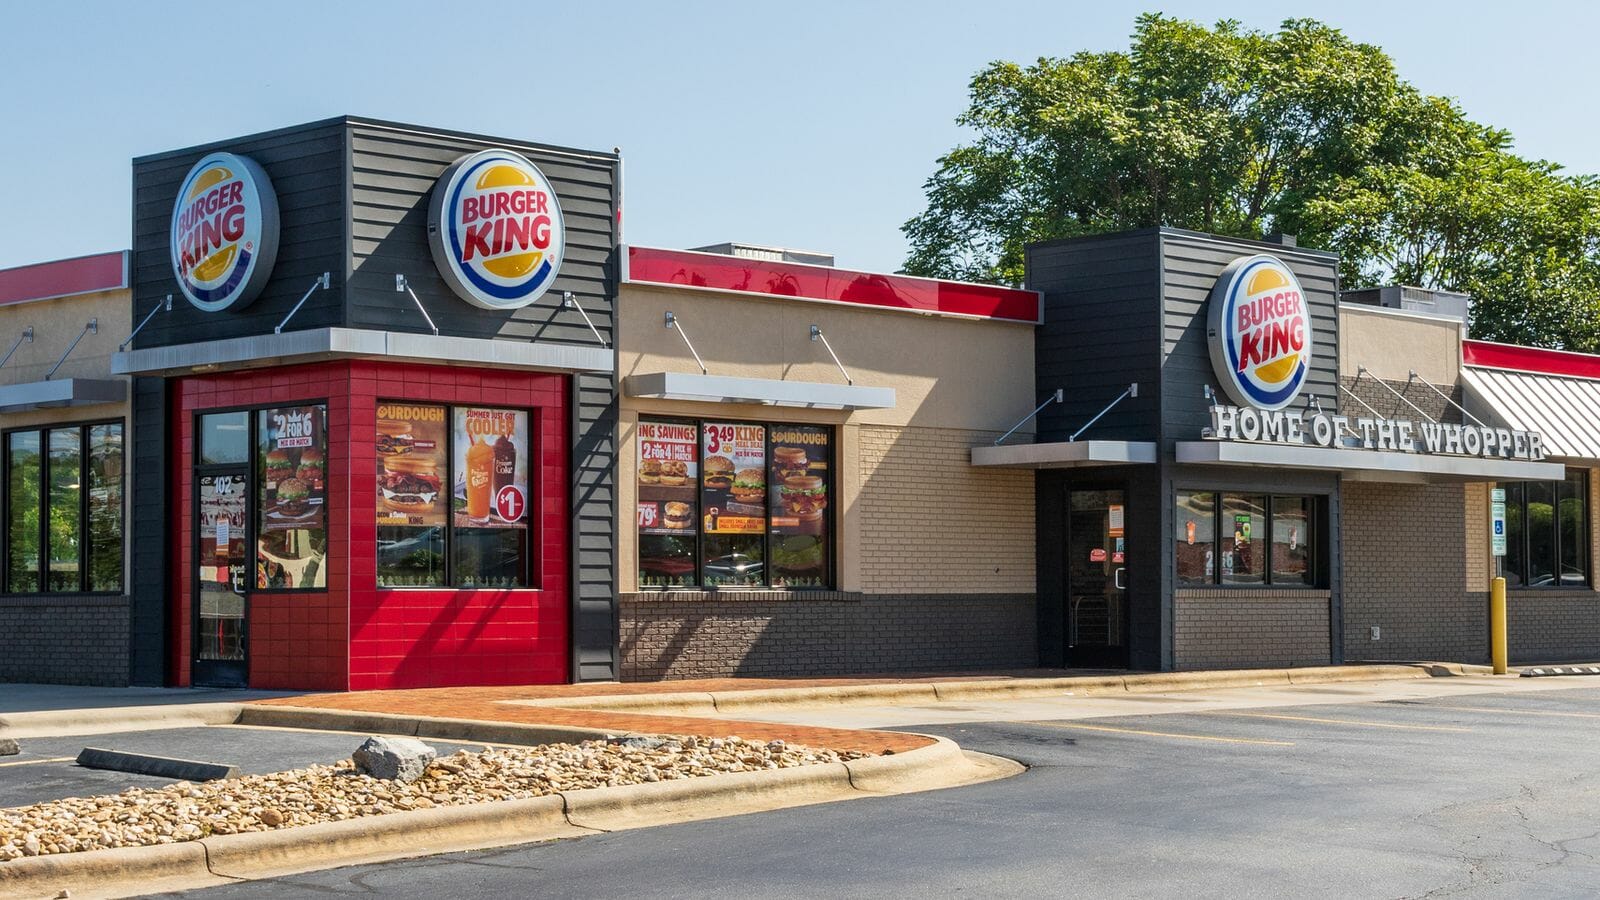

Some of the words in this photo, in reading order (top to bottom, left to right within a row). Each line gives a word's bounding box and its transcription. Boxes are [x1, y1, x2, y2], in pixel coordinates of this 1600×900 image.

[180, 181, 244, 240] BURGER
[462, 190, 548, 224] BURGER
[181, 204, 245, 279] KING
[463, 215, 551, 262] KING
[1238, 292, 1301, 333] BURGER
[1239, 316, 1304, 371] KING
[465, 418, 515, 435] COOLER
[466, 410, 490, 419] SUMMER
[491, 411, 503, 420] JUST
[504, 412, 516, 420] GOT
[287, 422, 302, 437] FOR
[736, 427, 764, 441] KING
[771, 431, 827, 445] SOURDOUGH
[1212, 405, 1304, 444] HOME
[1311, 414, 1348, 448] OF
[1357, 415, 1414, 453] THE
[1421, 422, 1546, 461] WHOPPER
[643, 443, 651, 459] 2
[215, 476, 232, 493] 102
